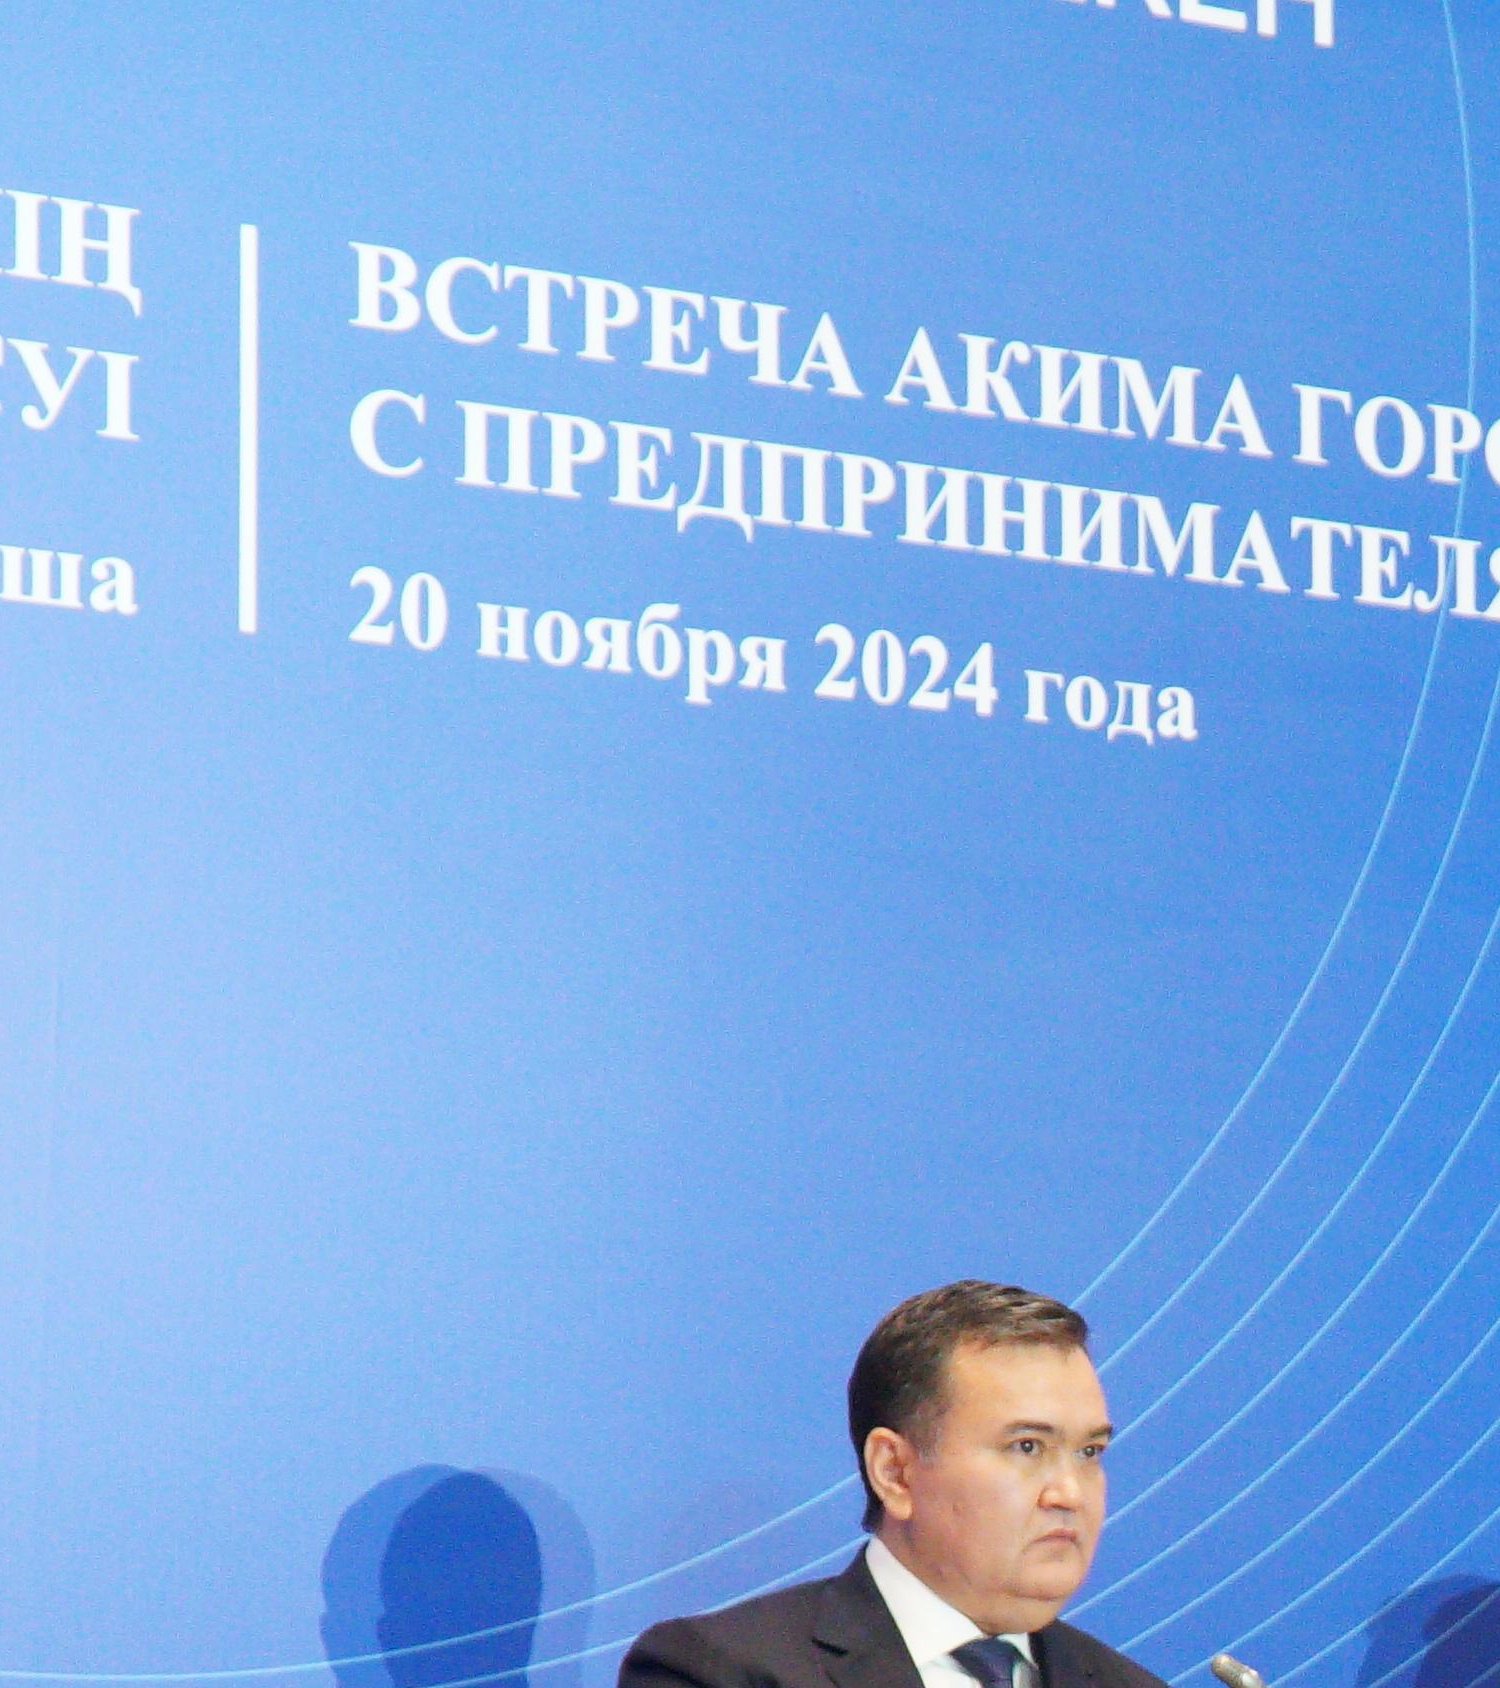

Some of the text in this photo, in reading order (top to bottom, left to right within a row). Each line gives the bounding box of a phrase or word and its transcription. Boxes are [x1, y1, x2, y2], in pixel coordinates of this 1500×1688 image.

[349, 241, 863, 398] ВСТРЕЧА
[885, 328, 1273, 457] АКИМА
[349, 389, 427, 478] С
[349, 566, 1198, 745] 20 ноября 2024 года
